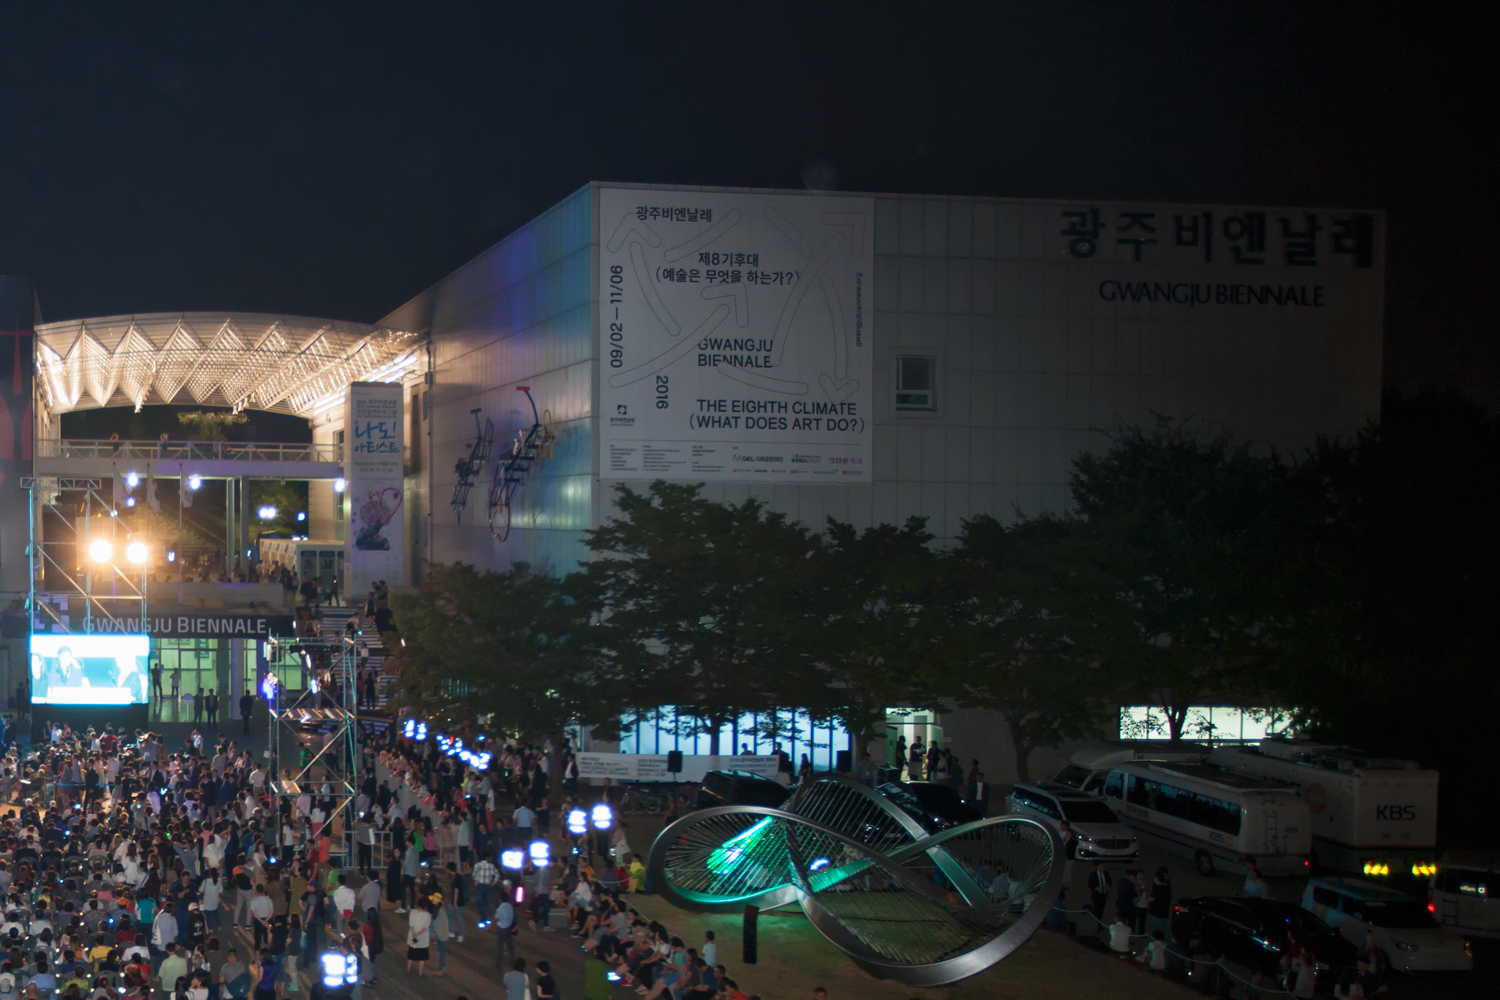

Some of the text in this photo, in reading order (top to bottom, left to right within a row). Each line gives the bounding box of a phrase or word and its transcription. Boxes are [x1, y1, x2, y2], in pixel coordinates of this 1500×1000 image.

[635, 206, 712, 223] 광주비엔날레
[1060, 208, 1373, 268] 광주비엔날레
[698, 252, 759, 268] 제8기후대
[656, 266, 800, 286] (예술은 무엇을 하는가?)
[1099, 280, 1325, 307] GWANGJU BIENNALE
[855, 272, 863, 347] gwangjubiennale.org
[697, 338, 773, 352] GWANGJU
[698, 354, 773, 368] BIENNALE
[656, 375, 669, 410] 2016
[697, 399, 856, 416] THE EIGHTH CLIMATE
[354, 421, 396, 439] 나도!
[689, 413, 865, 433] (WHAT DOES ART DO?)
[354, 441, 400, 453] 아티스트
[82, 615, 266, 634] GWANGJU BIENNALE
[1376, 805, 1416, 820] KBS
[1209, 830, 1225, 843] KBS
